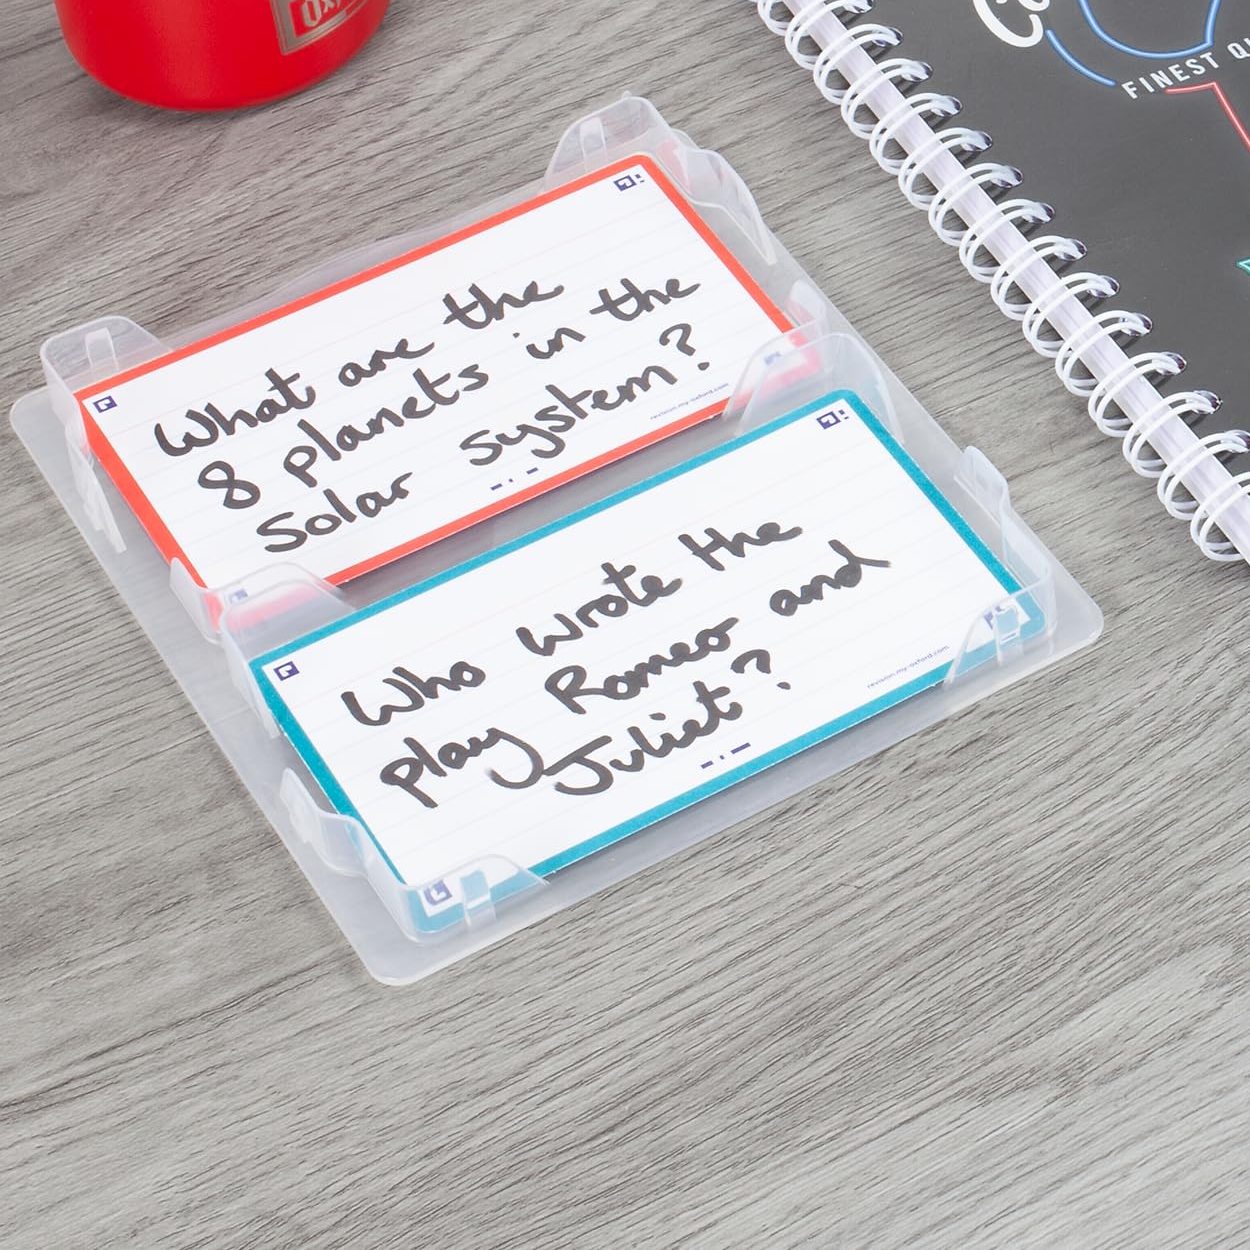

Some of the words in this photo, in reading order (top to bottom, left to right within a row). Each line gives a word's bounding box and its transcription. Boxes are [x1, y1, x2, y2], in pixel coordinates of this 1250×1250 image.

[1121, 51, 1221, 100] FINEST
[153, 367, 318, 458] What
[338, 337, 435, 387] are
[442, 279, 565, 330] the
[197, 460, 262, 510] 8
[283, 363, 490, 489] planets
[511, 323, 587, 360] in
[589, 277, 702, 322] the
[341, 659, 486, 727] Who
[677, 520, 804, 572] the
[379, 725, 546, 810] play
[544, 616, 739, 716] Romeo
[769, 539, 892, 618] and
